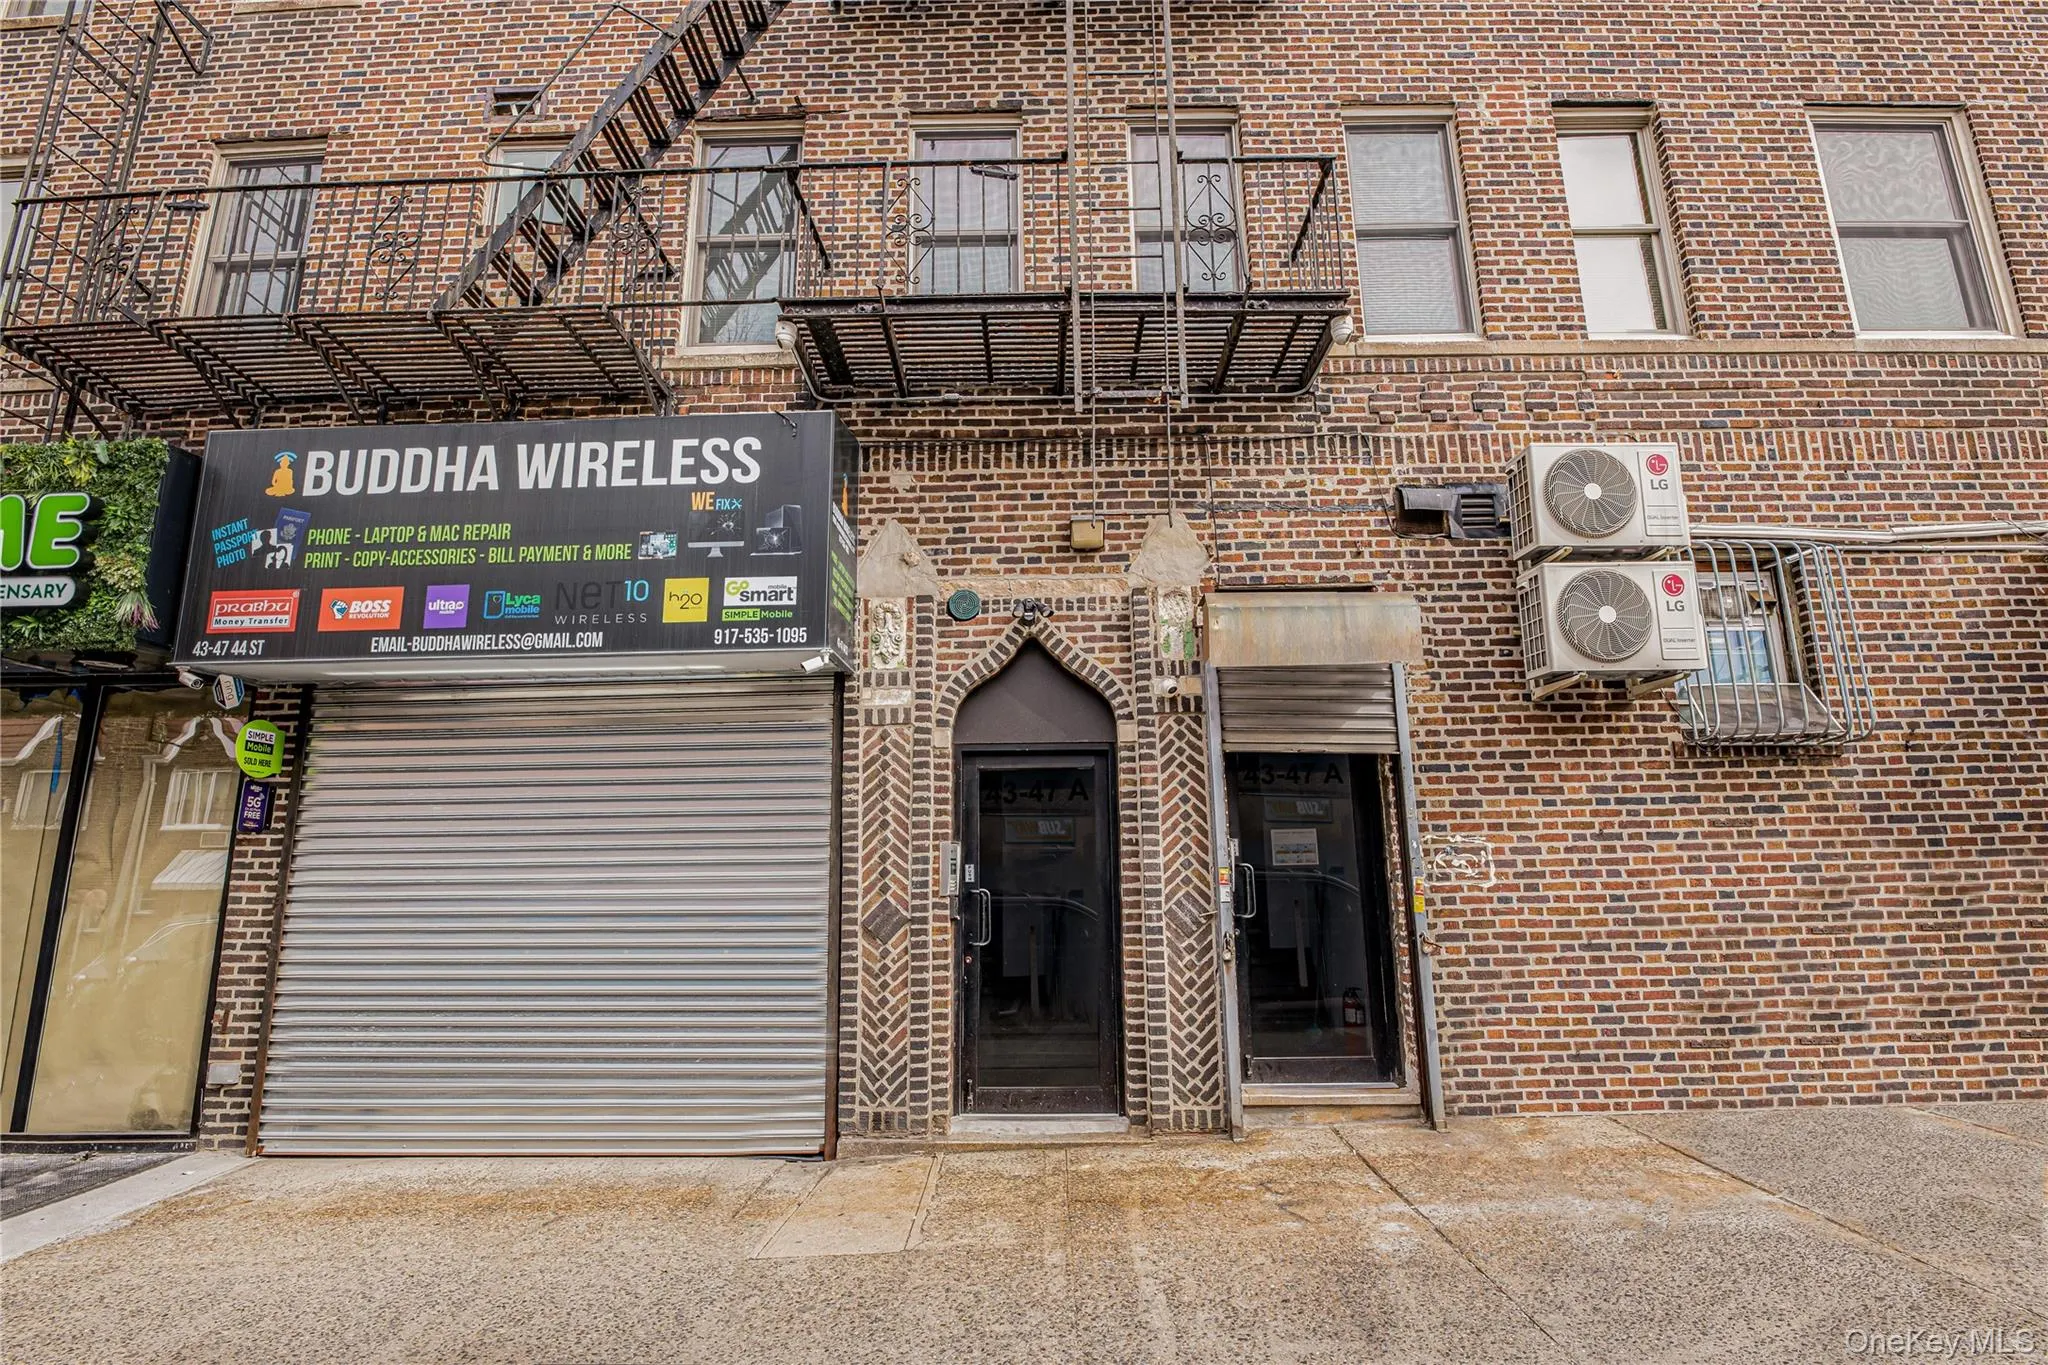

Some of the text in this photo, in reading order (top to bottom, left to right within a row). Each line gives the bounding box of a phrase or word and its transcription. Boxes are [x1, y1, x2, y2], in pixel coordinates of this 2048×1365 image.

[302, 436, 762, 497] BUDDHA WIRELESS
[1650, 479, 1669, 491] LG
[691, 491, 731, 511] WE FIX
[211, 518, 248, 541] INSTANT
[307, 528, 352, 545] PHONE
[364, 526, 415, 544] LAPTOP
[417, 525, 427, 542] &
[429, 524, 460, 542] MAC
[463, 523, 511, 540] REPAIR
[216, 548, 246, 569] PHOTO
[304, 552, 342, 569] PRINT
[352, 548, 477, 567] COPY-ACCESSORIES
[488, 547, 515, 563] BILL
[519, 545, 580, 562] PAYMENT
[583, 545, 592, 561] &
[595, 543, 632, 560] MORE
[506, 592, 541, 607] Lyca
[739, 586, 794, 602] smart
[349, 600, 392, 613] BOSS
[505, 605, 540, 614] mobile
[1666, 600, 1685, 612] LG
[348, 612, 390, 620] REVOLUTION
[554, 612, 648, 625] WIRELESS
[724, 609, 793, 619] SIMPLE Mobile
[214, 617, 288, 628] Money Transfer
[370, 631, 603, 653] EMAIL-BUDDHAWIRELESS@GMAIL.COM
[714, 627, 808, 645] 917-535-1095
[192, 640, 265, 657] 43-47 44 ST
[247, 730, 274, 743] SIMPLE
[246, 741, 272, 754] Mobile
[243, 756, 272, 768] SOLD HERE
[1243, 763, 1344, 785] 43-47 A
[986, 777, 1089, 804] 43-47 A
[246, 796, 261, 808] 5G
[243, 811, 261, 820] FREE
